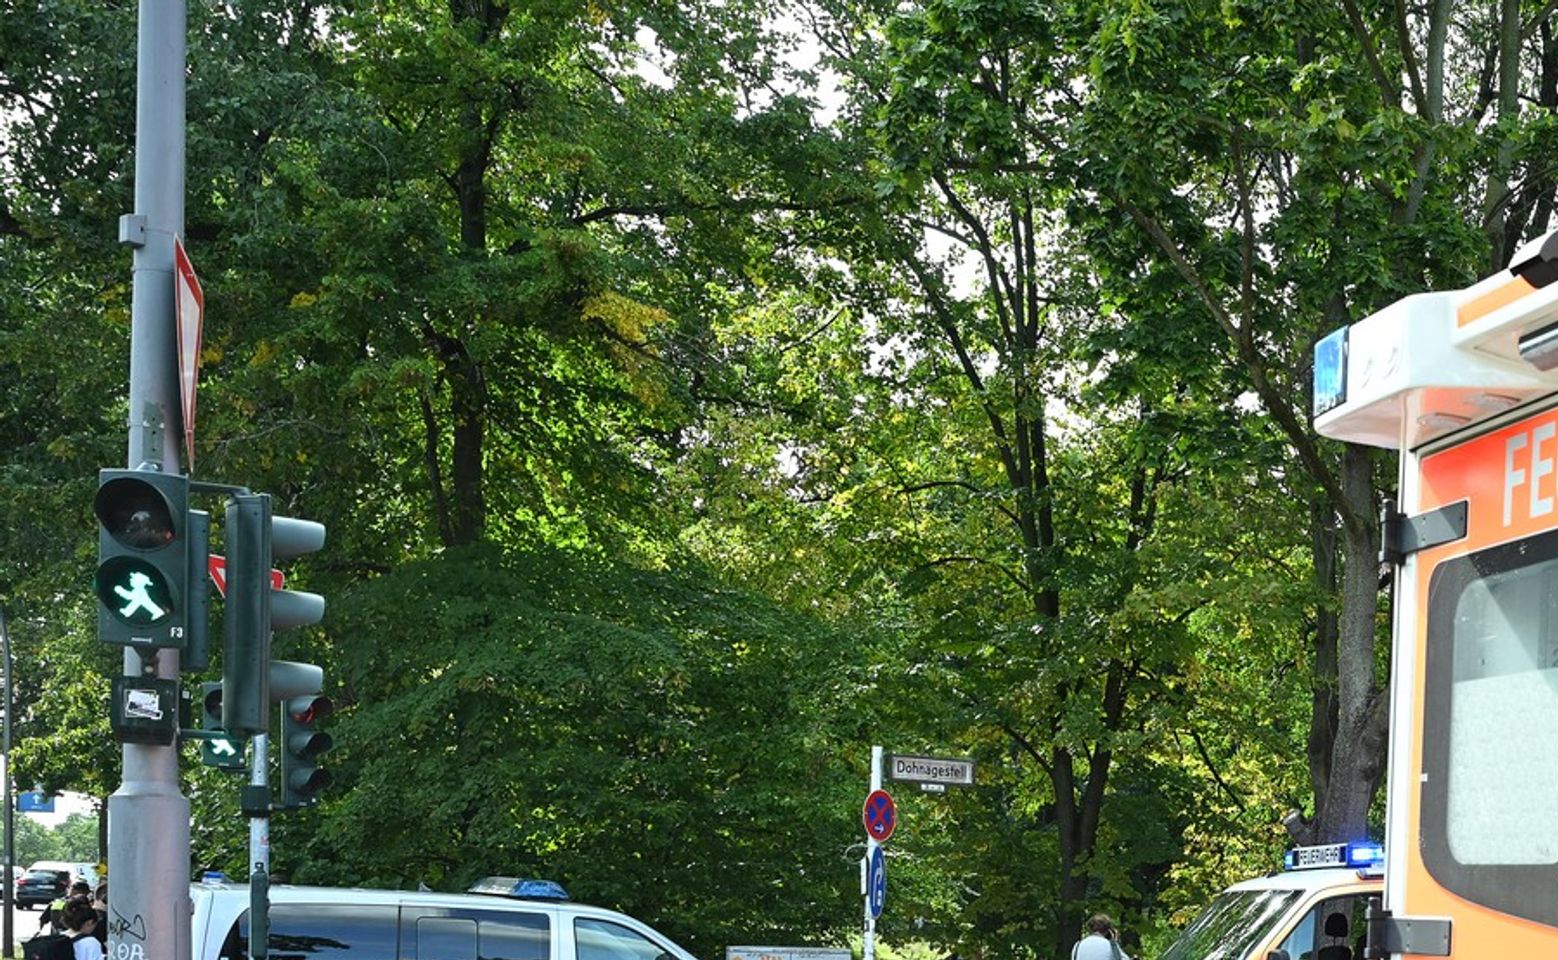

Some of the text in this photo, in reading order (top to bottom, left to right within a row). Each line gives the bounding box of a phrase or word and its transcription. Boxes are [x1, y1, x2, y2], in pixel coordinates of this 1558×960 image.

[170, 627, 184, 638] F3
[896, 760, 968, 779] Dohnagestell
[1299, 847, 1340, 866] FEUERWEHR
